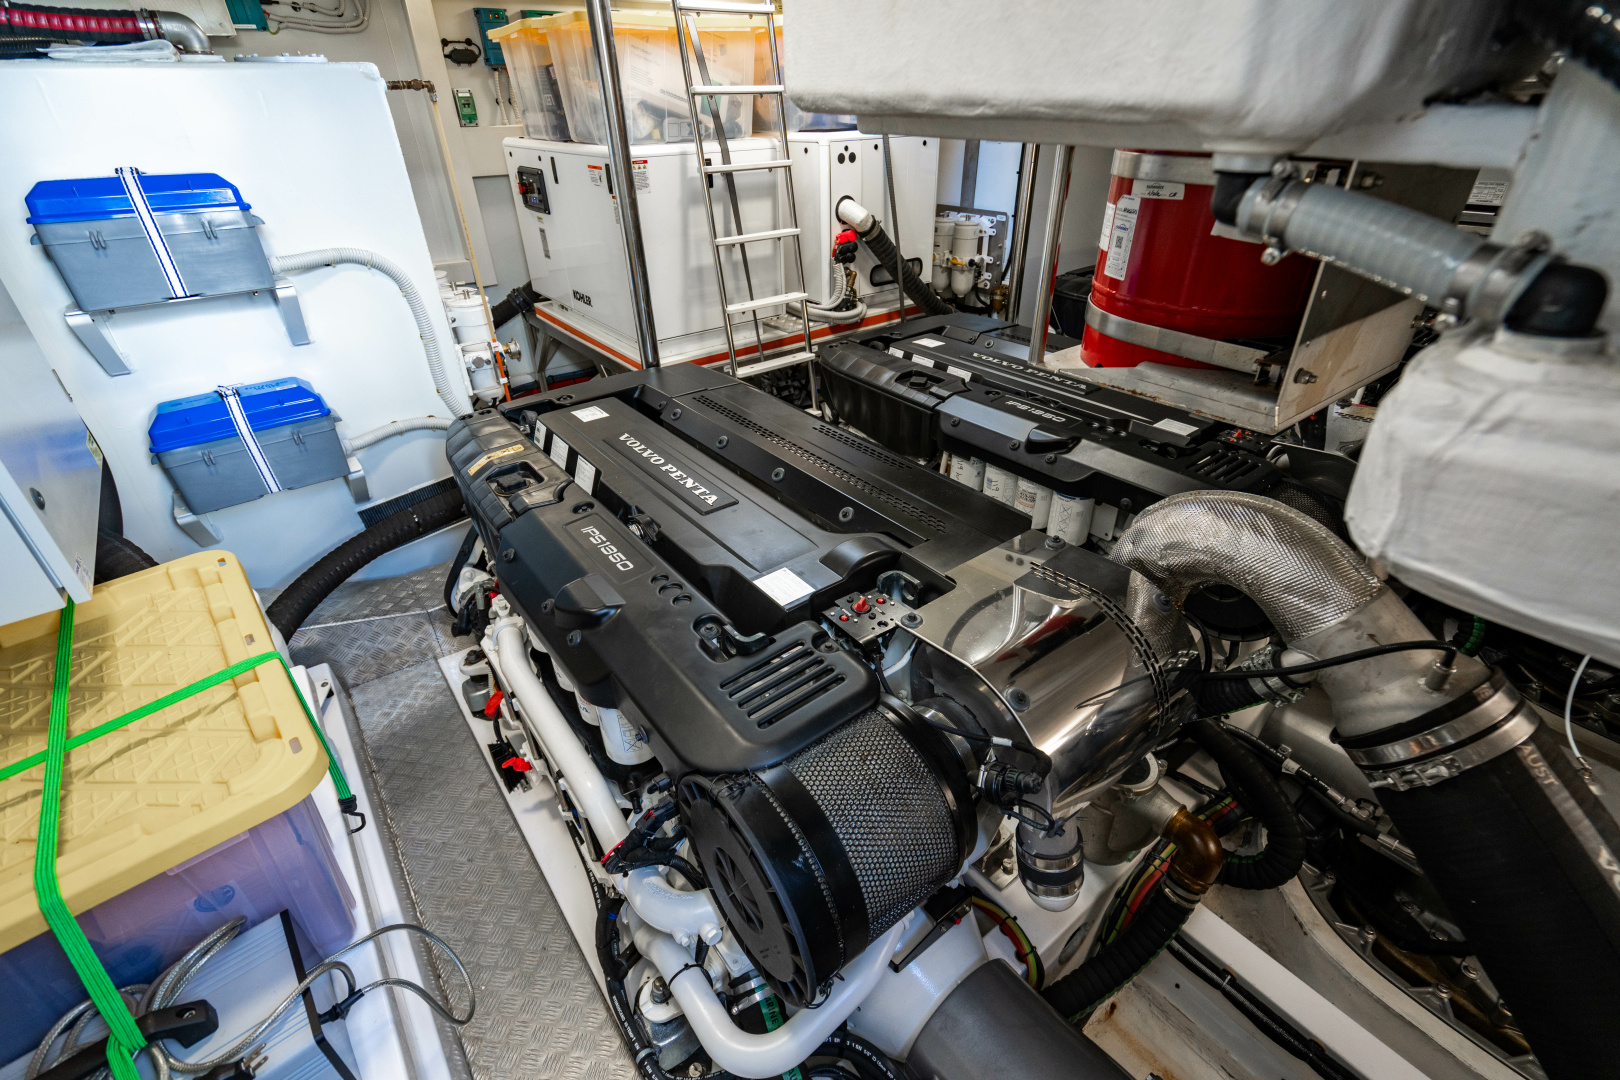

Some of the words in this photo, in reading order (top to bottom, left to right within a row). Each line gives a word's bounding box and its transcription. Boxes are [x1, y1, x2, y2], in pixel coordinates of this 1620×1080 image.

[572, 289, 593, 307] KOHLER
[972, 352, 1024, 370] VOLVO
[1023, 368, 1087, 390] PENTA
[619, 432, 665, 465] VOLVO
[660, 463, 718, 506] PENTA
[581, 525, 634, 571] IPS1350
[1516, 744, 1559, 786] AUST
[765, 997, 780, 1025] ARINE
